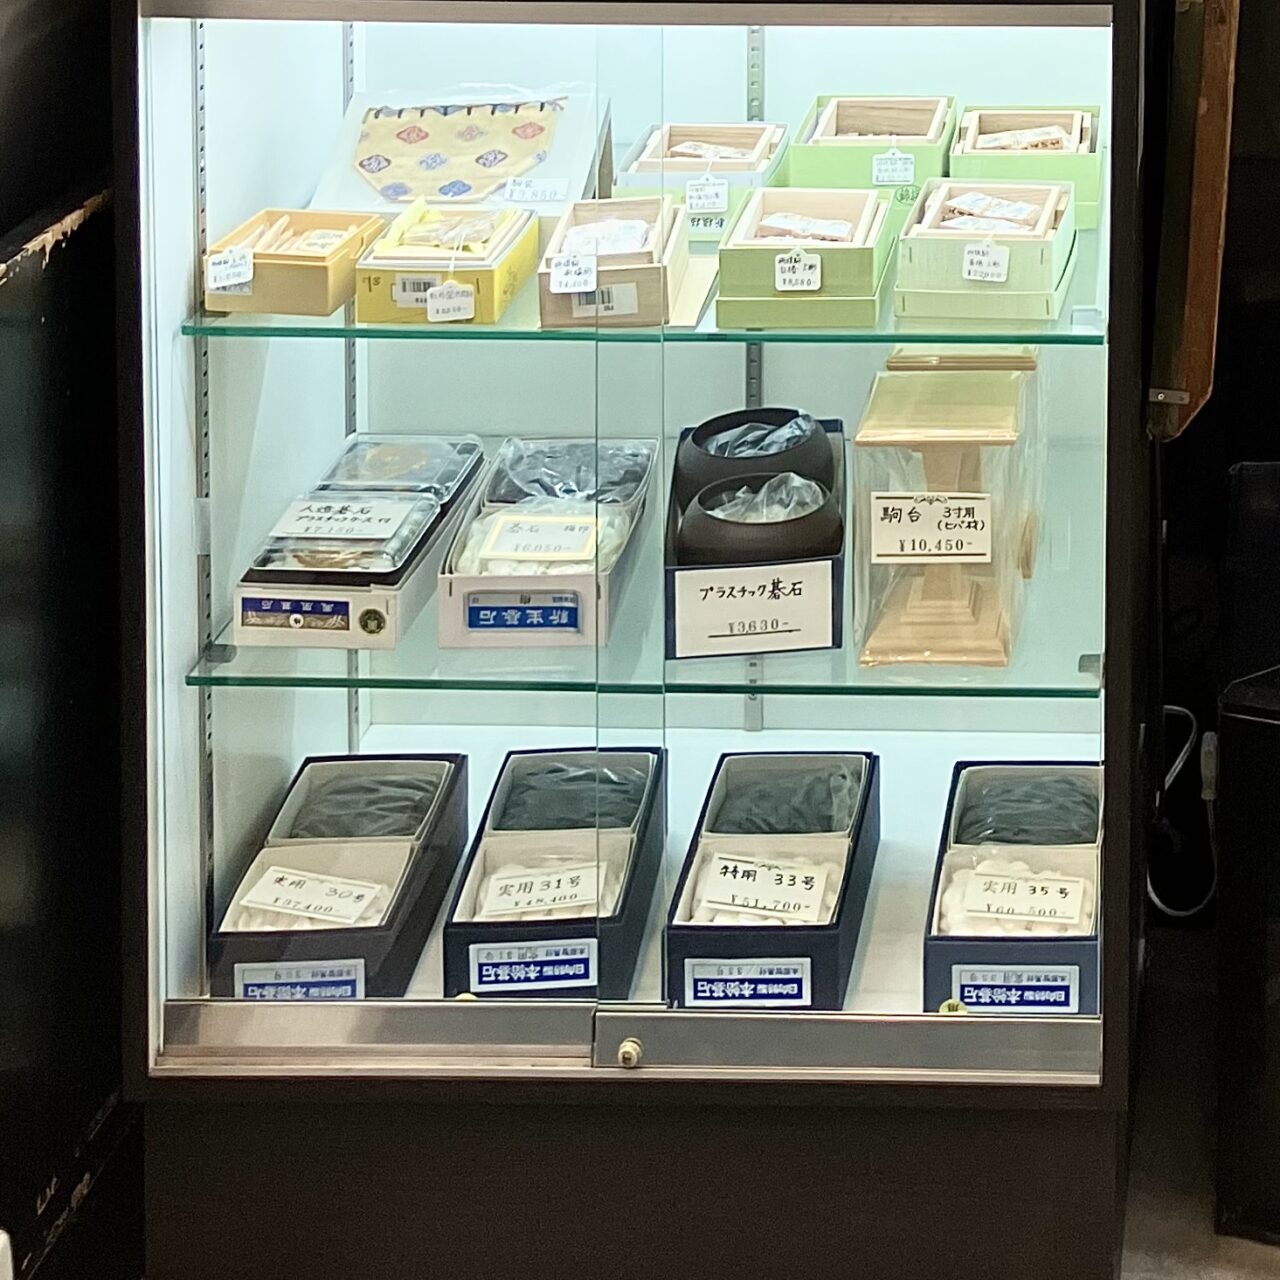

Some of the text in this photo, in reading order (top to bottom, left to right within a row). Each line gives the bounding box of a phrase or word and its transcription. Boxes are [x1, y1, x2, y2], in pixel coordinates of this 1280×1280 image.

[880, 506, 975, 524] 駒台 3寸用
[699, 577, 803, 601] プラスチック碁石
[479, 609, 569, 625] 新生碁石
